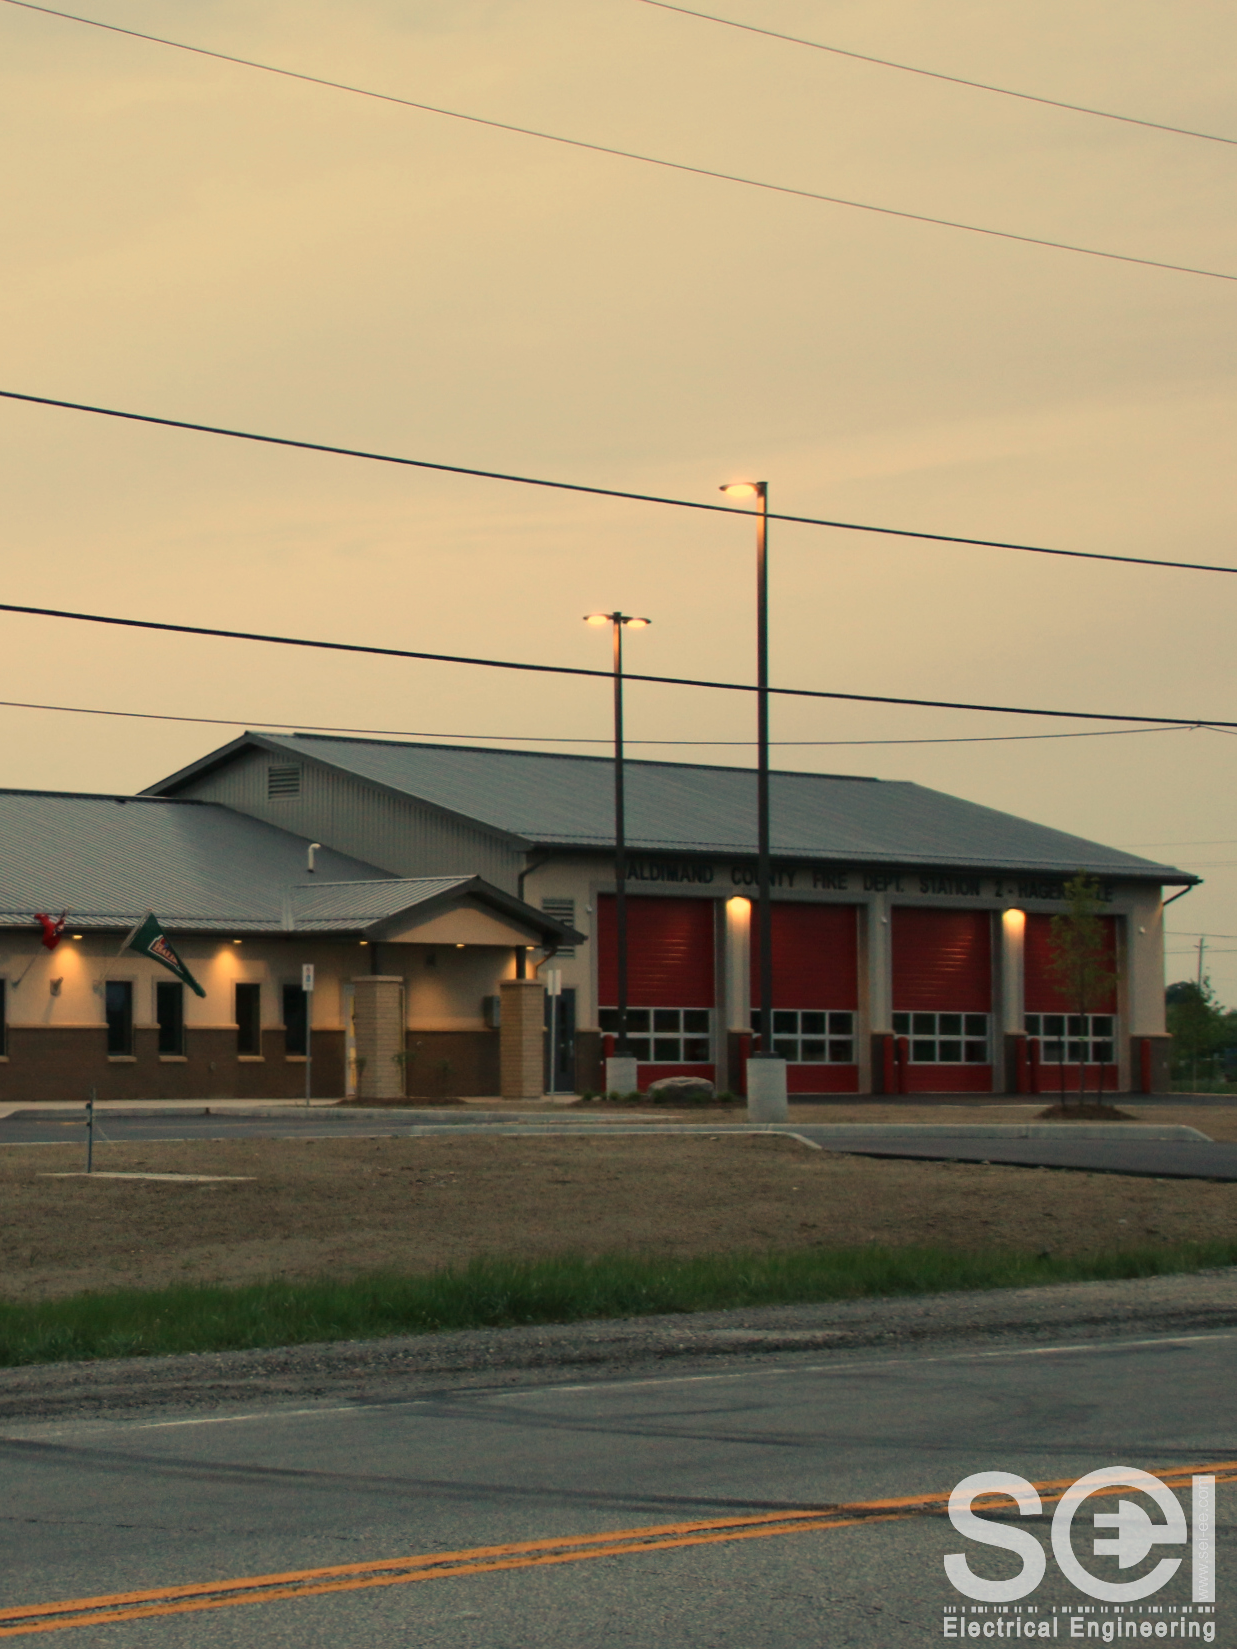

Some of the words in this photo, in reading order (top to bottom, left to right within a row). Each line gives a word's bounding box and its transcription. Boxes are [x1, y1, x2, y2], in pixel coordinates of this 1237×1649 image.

[617, 862, 714, 884] ALDIMAND
[813, 871, 848, 891] FIRE
[919, 877, 981, 896] STATION
[994, 880, 1004, 898] 2
